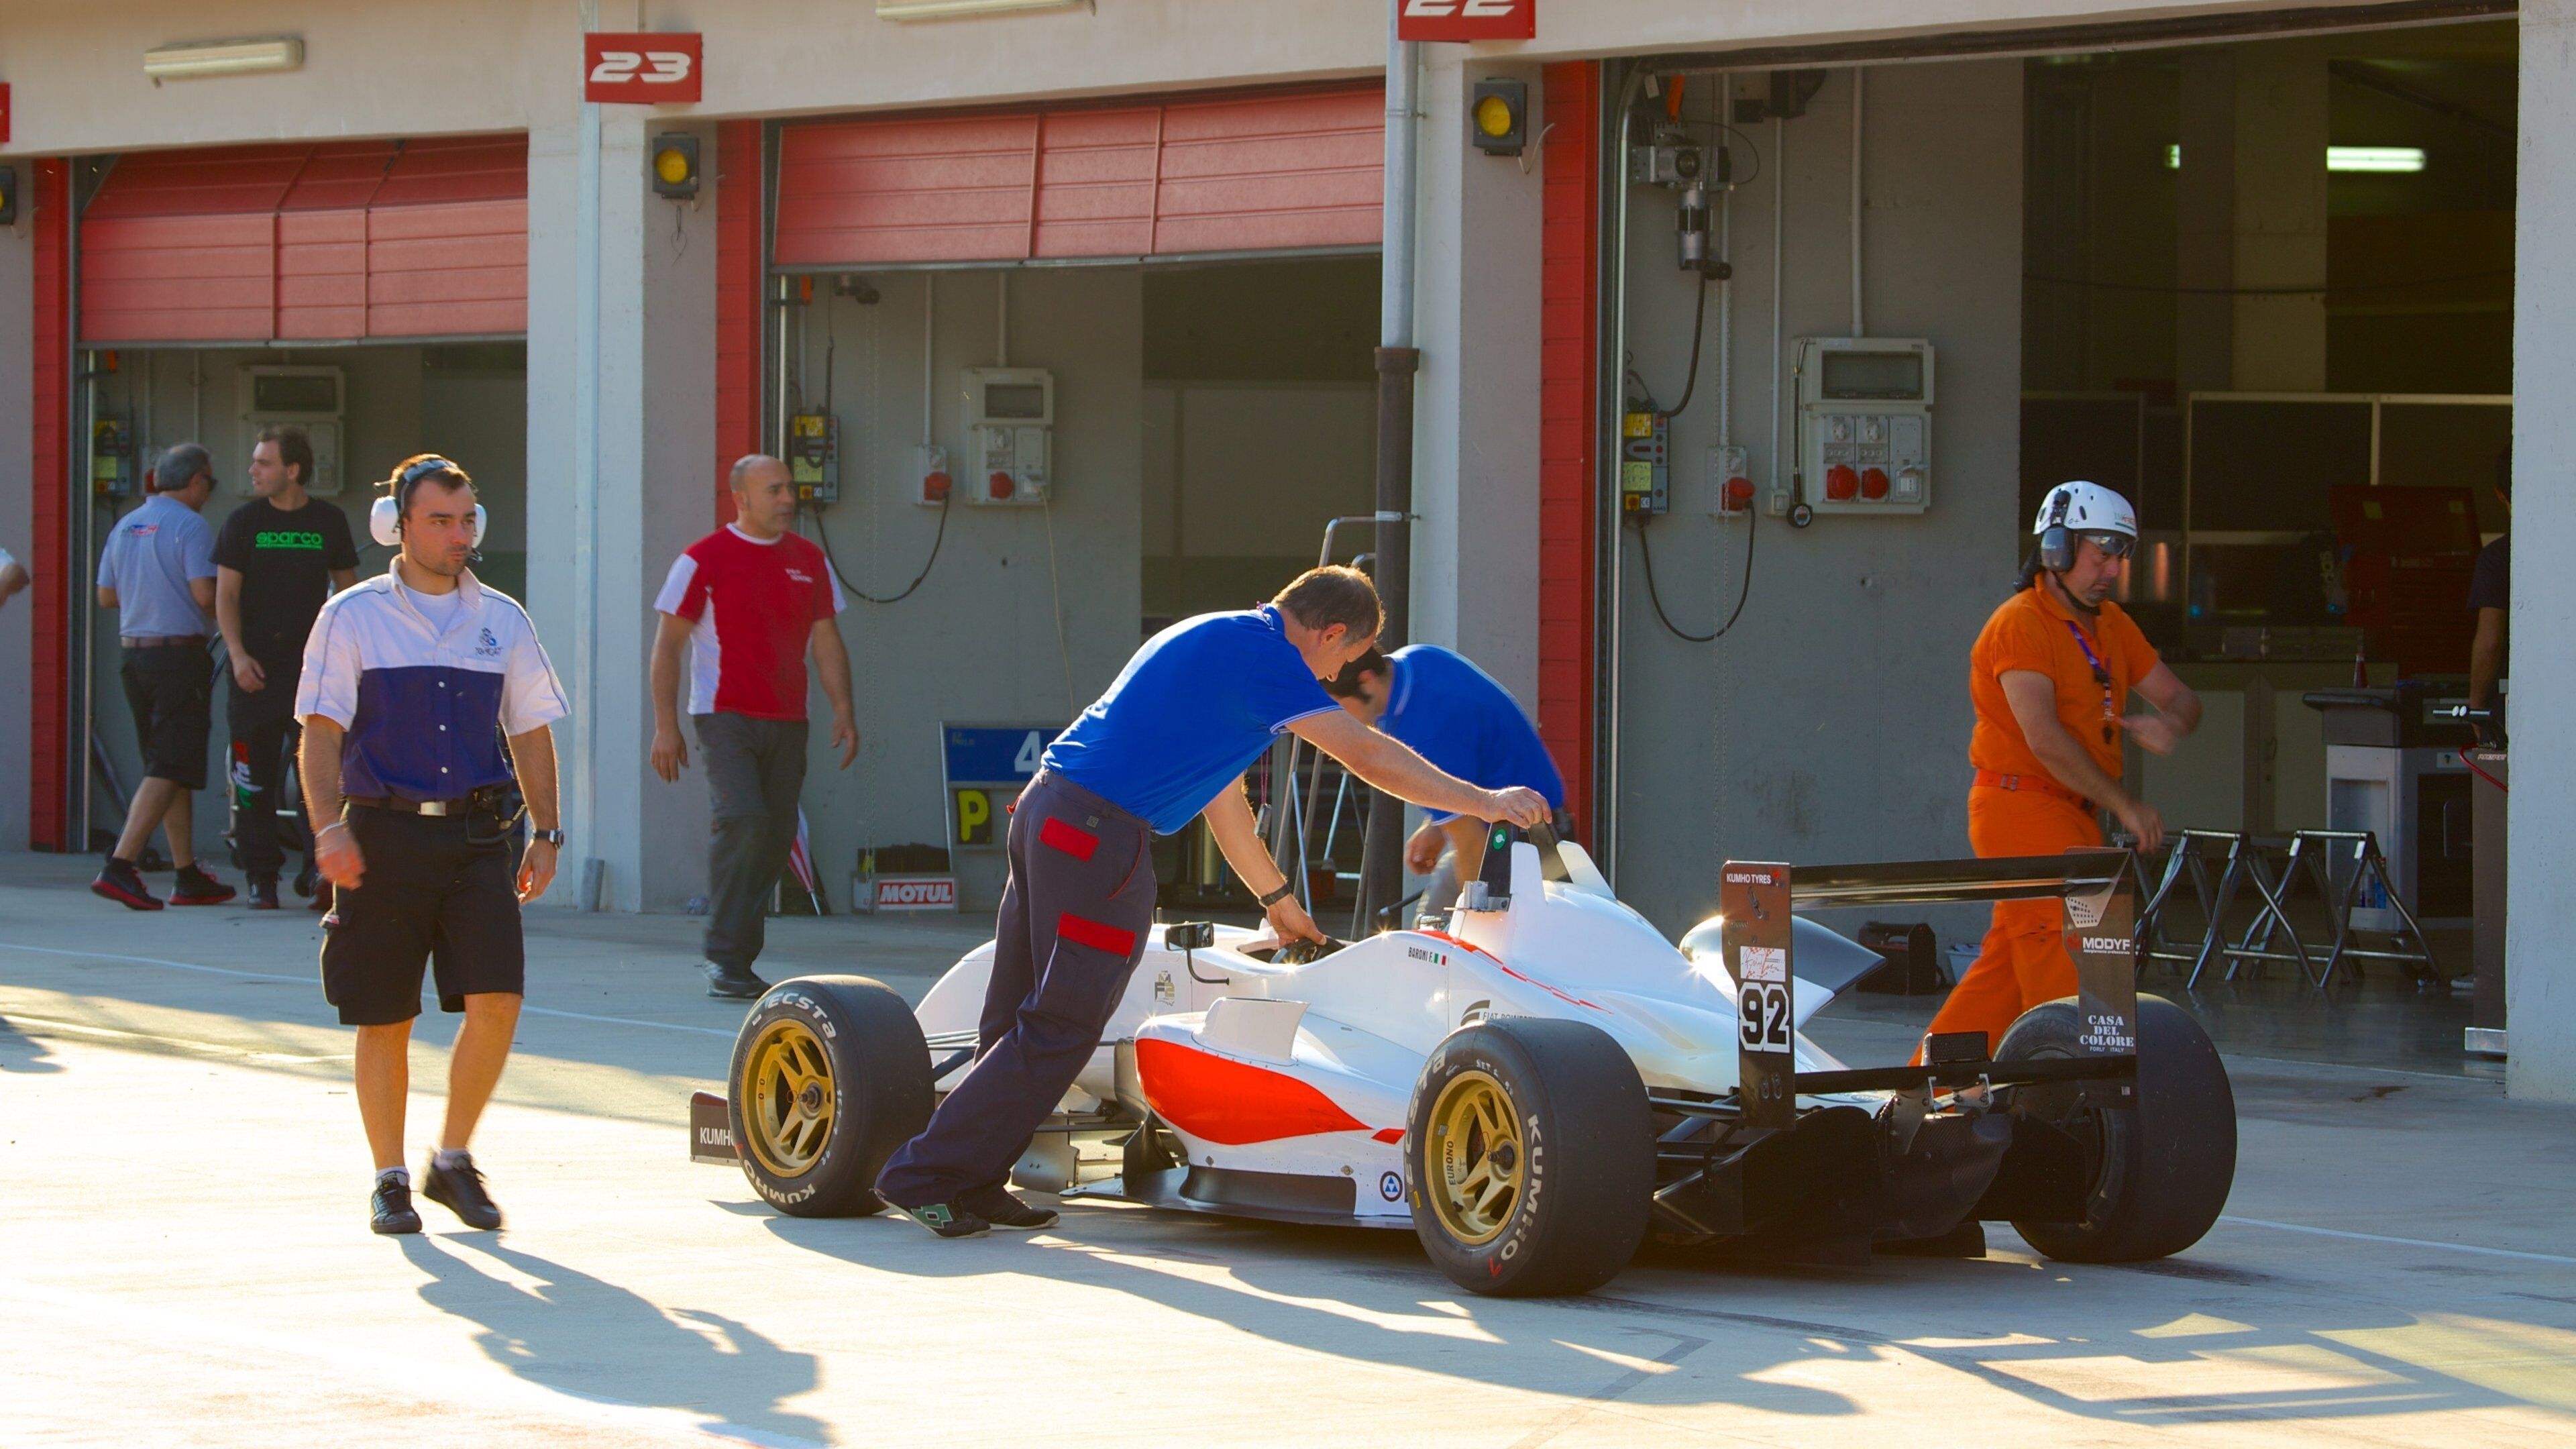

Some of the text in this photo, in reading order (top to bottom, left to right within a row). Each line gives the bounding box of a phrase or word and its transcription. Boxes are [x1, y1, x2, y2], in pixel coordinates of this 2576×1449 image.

[589, 51, 691, 83] 23
[256, 531, 322, 549] sparco
[1014, 731, 1040, 775] 4
[958, 790, 989, 842] P
[1727, 873, 1772, 885] KUMHO TYRES
[879, 884, 952, 903] MOTUL
[2082, 936, 2131, 950] MODYF
[1408, 947, 1428, 961] BARONI
[1483, 1012, 1499, 1020] FIAT
[1739, 983, 1790, 1052] 92
[2088, 1014, 2125, 1026] CASA
[2094, 1025, 2120, 1036] DEL
[2080, 1034, 2134, 1047] COLORE
[743, 1159, 816, 1204] KUMHO
[1501, 1114, 1543, 1260] KUMHO
